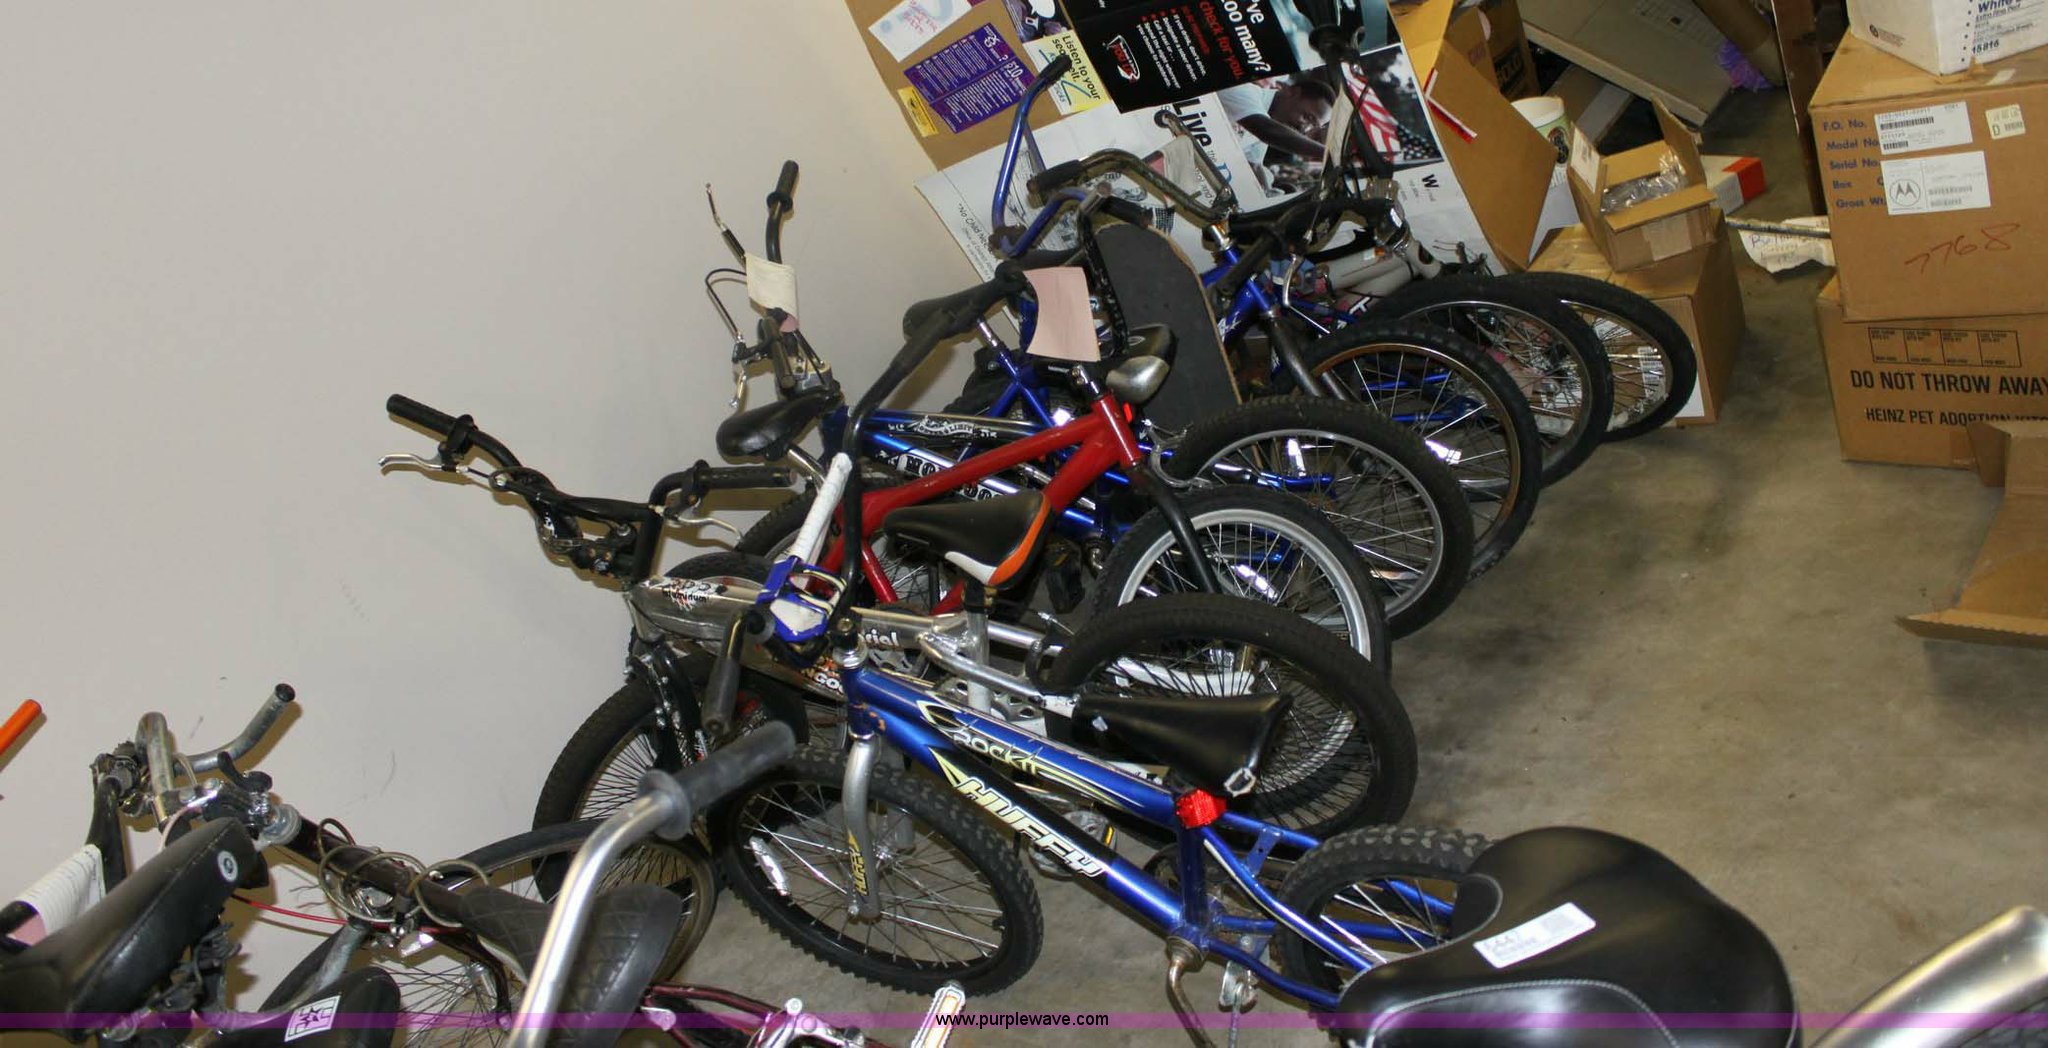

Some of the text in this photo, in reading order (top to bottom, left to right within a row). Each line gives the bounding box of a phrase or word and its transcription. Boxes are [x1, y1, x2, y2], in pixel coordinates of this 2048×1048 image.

[1217, 35, 1234, 54] for
[1221, 0, 1272, 74] oo many?
[1062, 35, 1101, 101] Listen to your
[1172, 98, 1213, 151] Live
[1827, 137, 1859, 150] Model
[1830, 159, 1858, 171] Serial
[1836, 198, 1865, 210] Gross
[1850, 369, 1875, 388] DO
[1880, 371, 1917, 390] NOT
[1921, 373, 1990, 393] THROW
[1866, 407, 1906, 423] HEINZ
[1909, 410, 1935, 425] PET
[956, 776, 1105, 877] HUFFY
